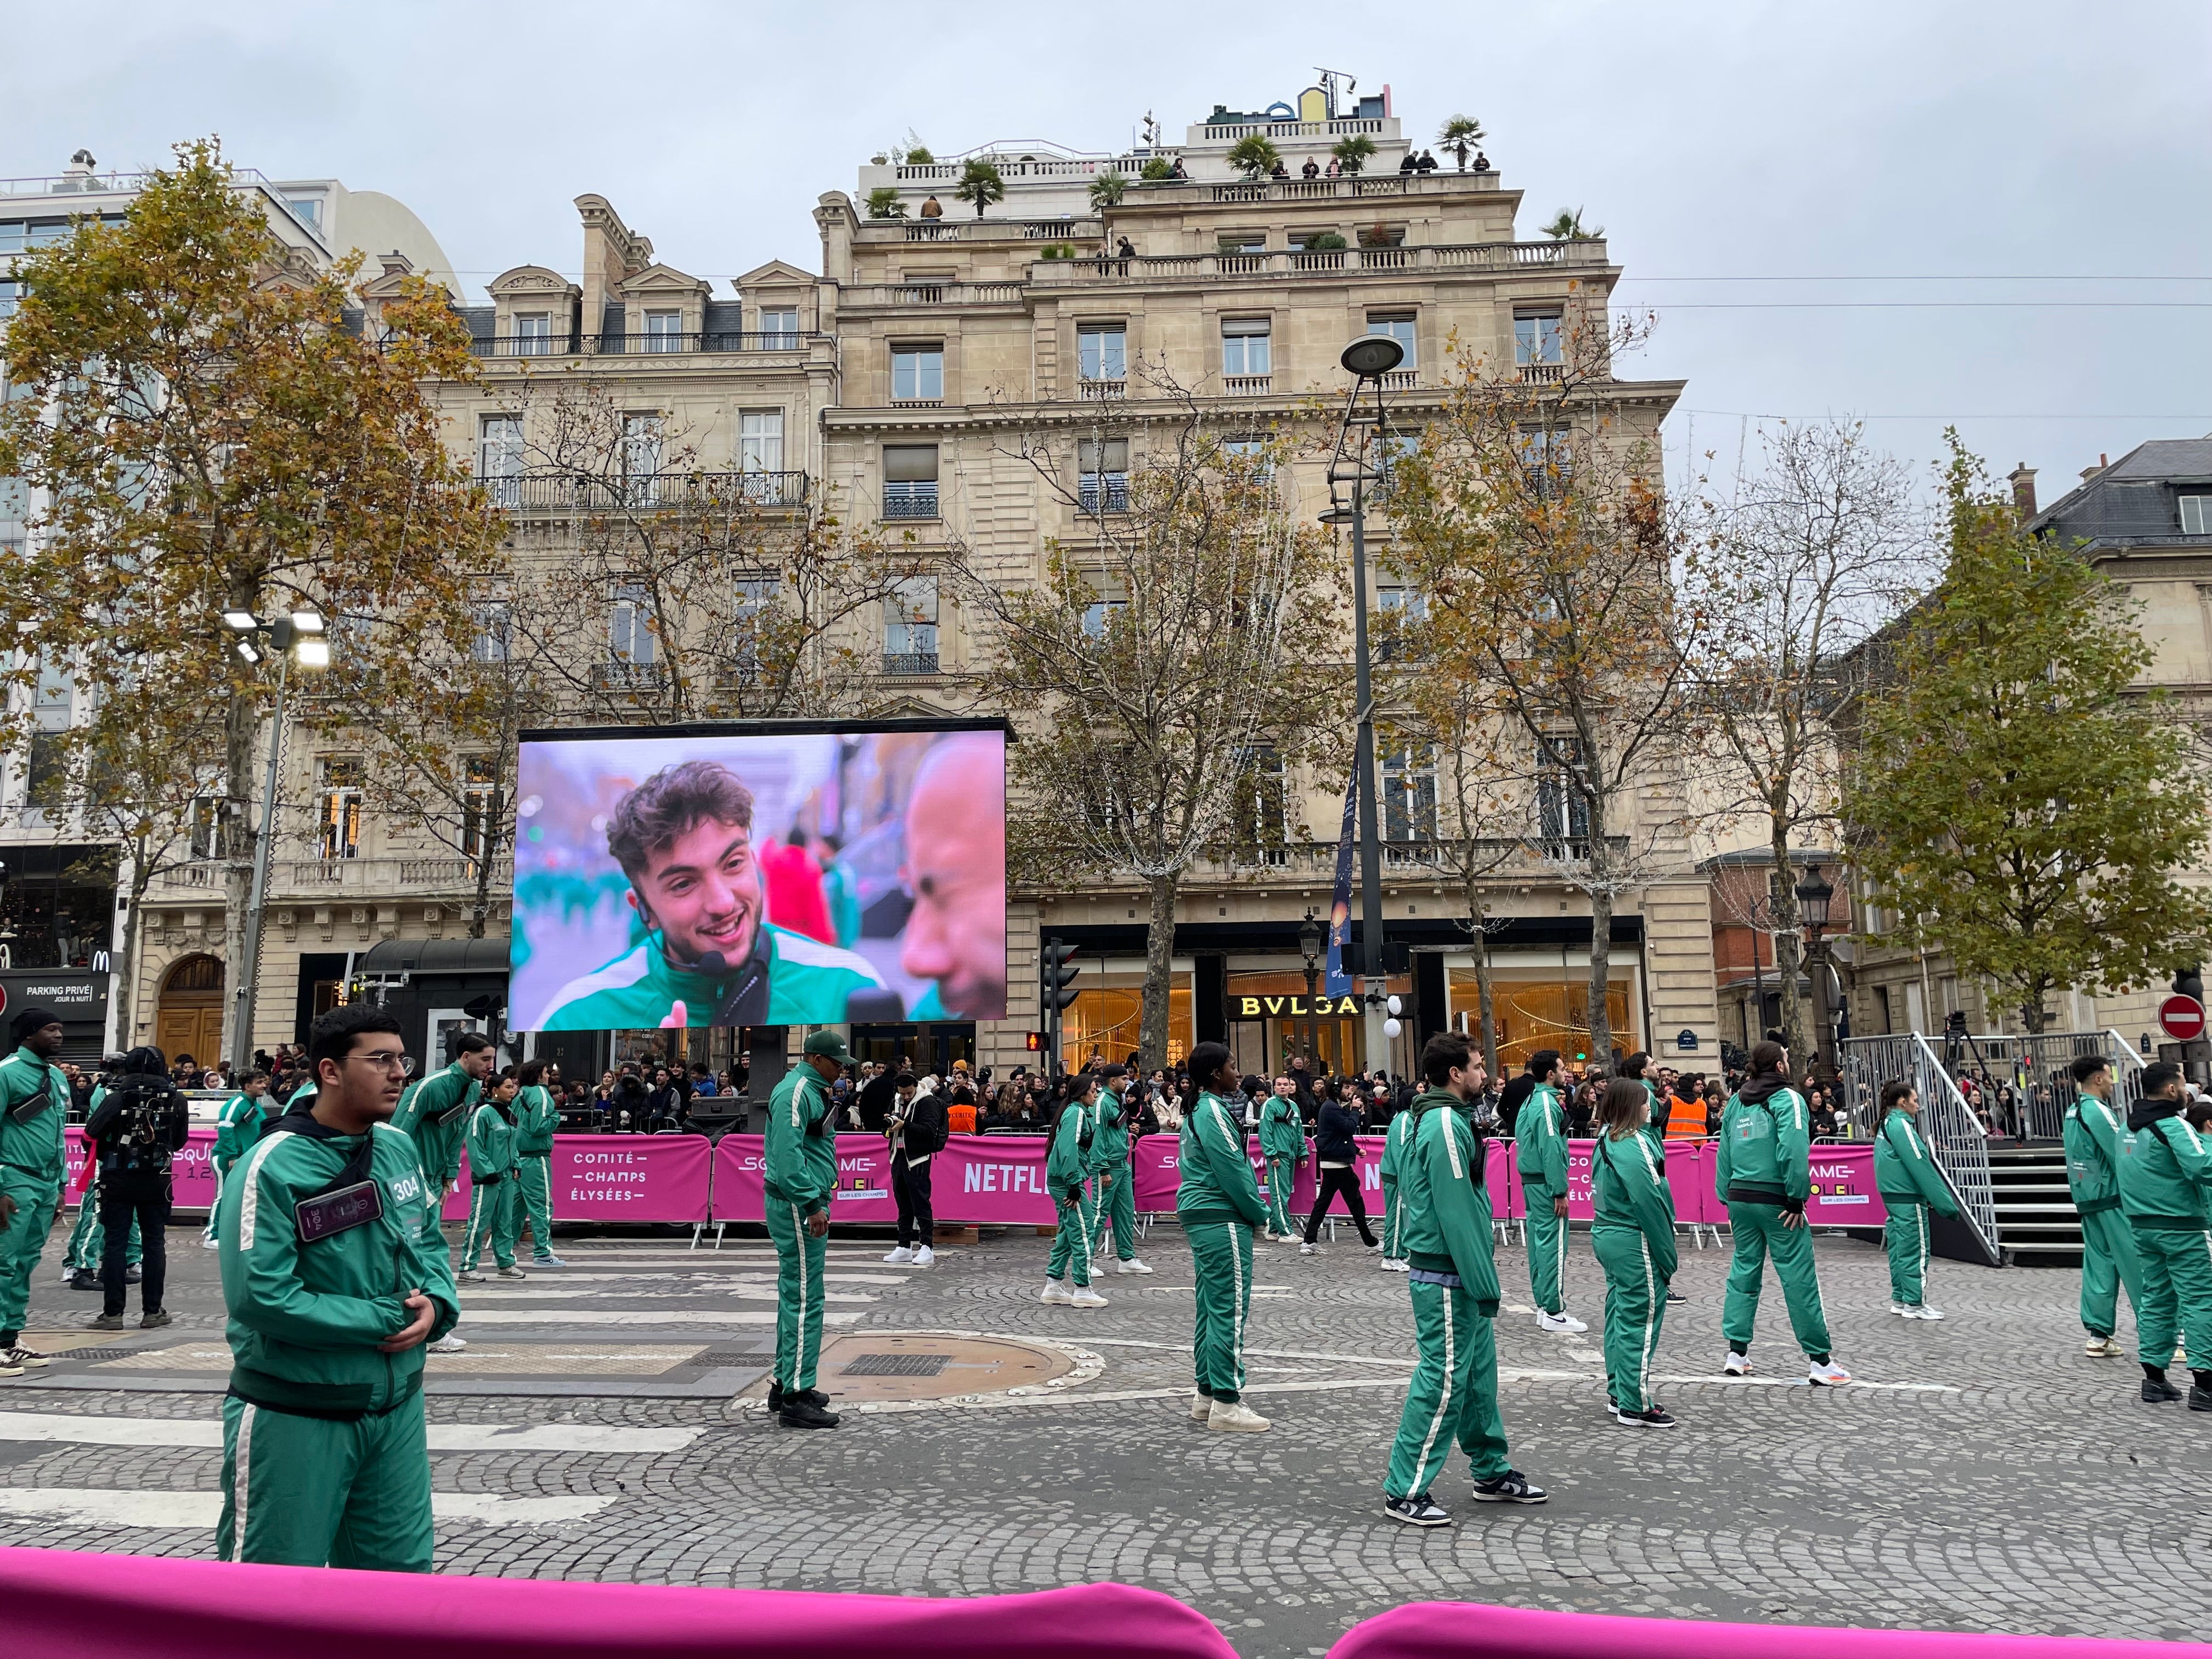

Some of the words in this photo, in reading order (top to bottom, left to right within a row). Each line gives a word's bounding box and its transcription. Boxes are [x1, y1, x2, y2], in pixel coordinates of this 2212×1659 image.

[27, 986, 63, 995] PARKING
[65, 984, 90, 995] PRIVÉ
[393, 1176, 420, 1201] 304
[310, 1209, 323, 1231] 304
